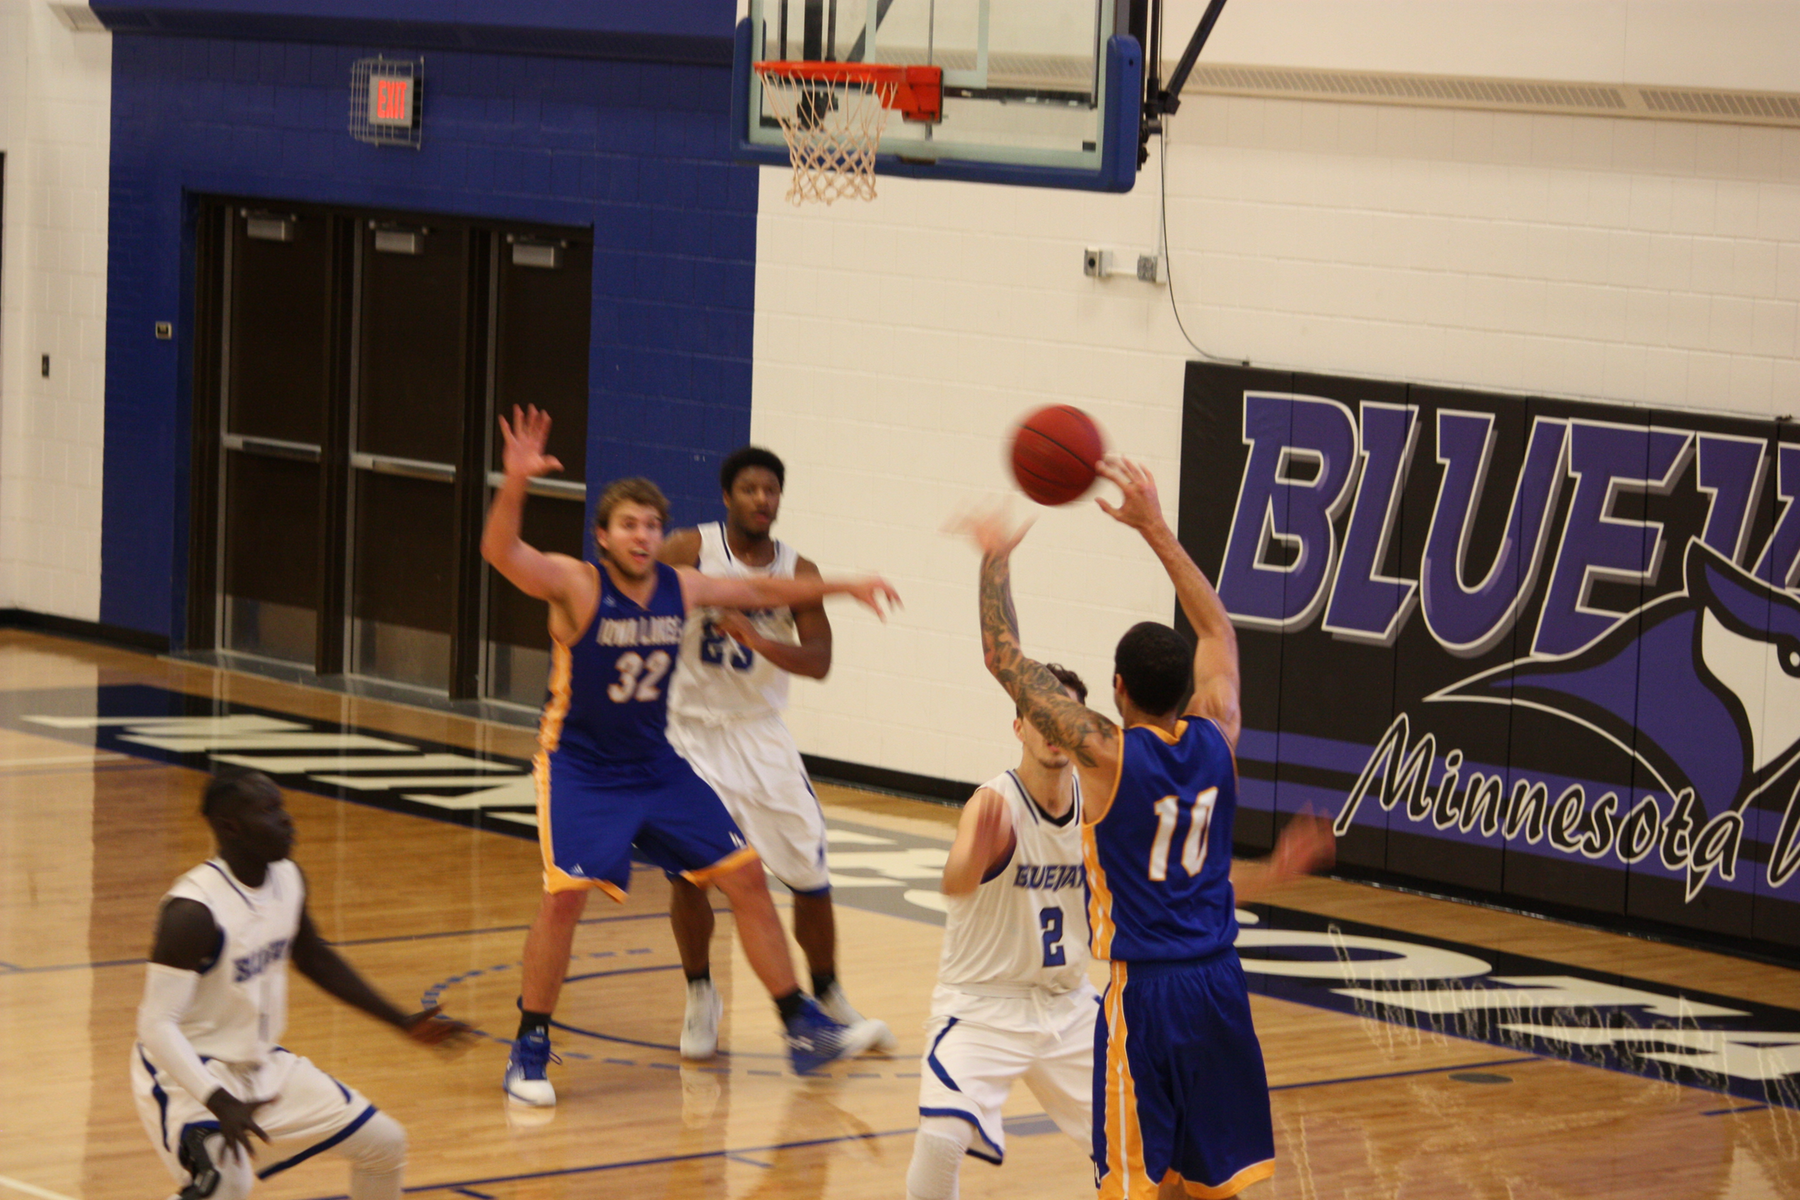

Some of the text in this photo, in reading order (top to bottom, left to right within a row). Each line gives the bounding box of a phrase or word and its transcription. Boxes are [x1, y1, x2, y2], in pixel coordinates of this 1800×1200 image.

[377, 80, 407, 119] EXIT
[606, 650, 672, 703] 32
[1333, 711, 1743, 882] Minnesota
[1148, 786, 1219, 881] 10
[1039, 906, 1066, 968] 2
